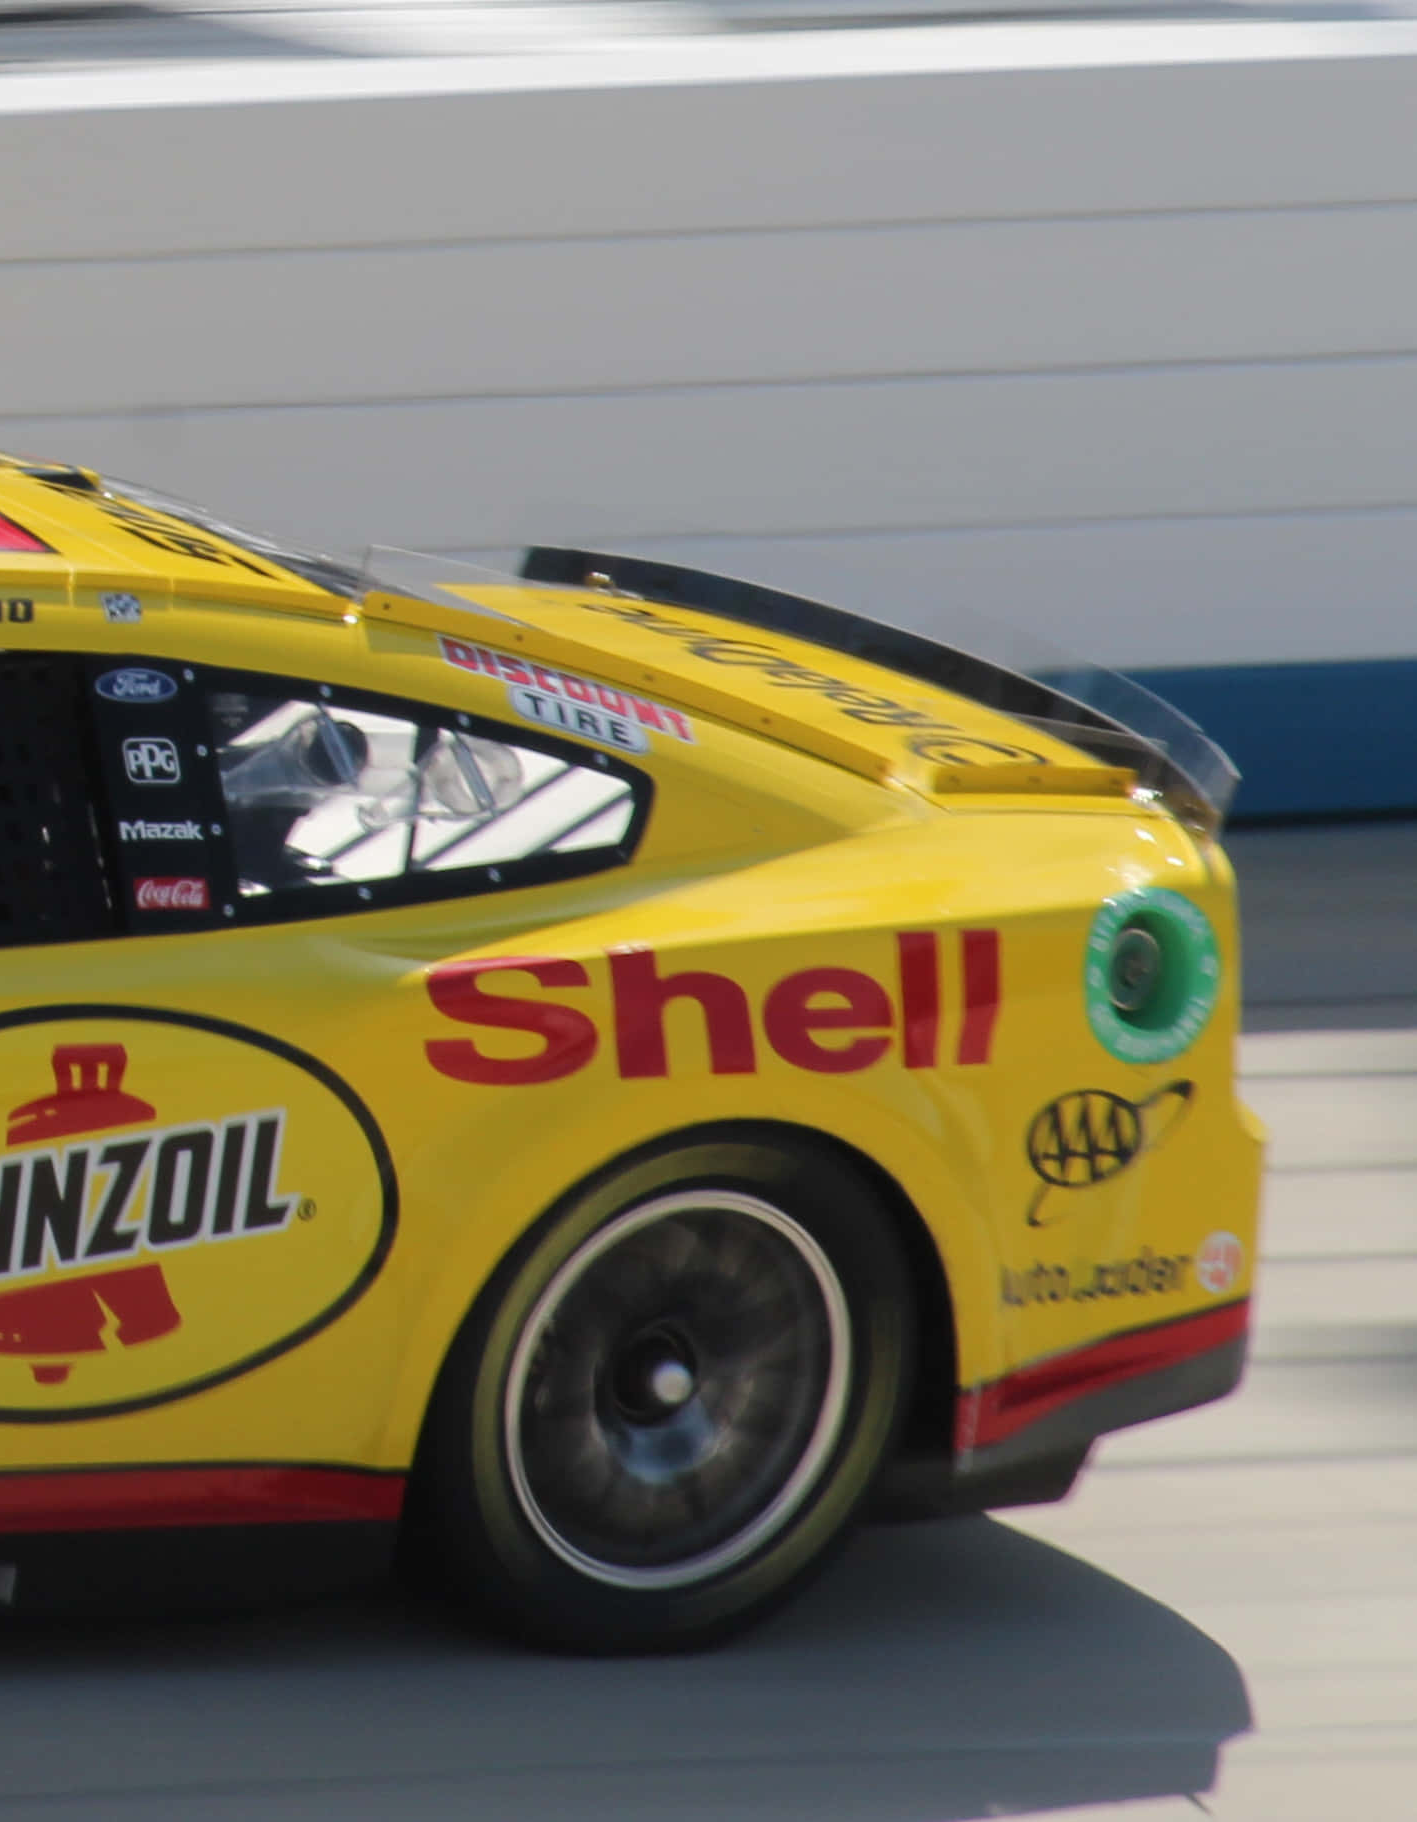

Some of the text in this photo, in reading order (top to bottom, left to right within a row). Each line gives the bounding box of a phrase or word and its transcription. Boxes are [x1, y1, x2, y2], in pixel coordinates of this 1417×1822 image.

[439, 636, 697, 743] DISCOUNT
[522, 691, 633, 746] TIRE
[127, 742, 177, 779] PPG
[118, 820, 204, 841] Mazak
[423, 926, 1002, 1088] Shell
